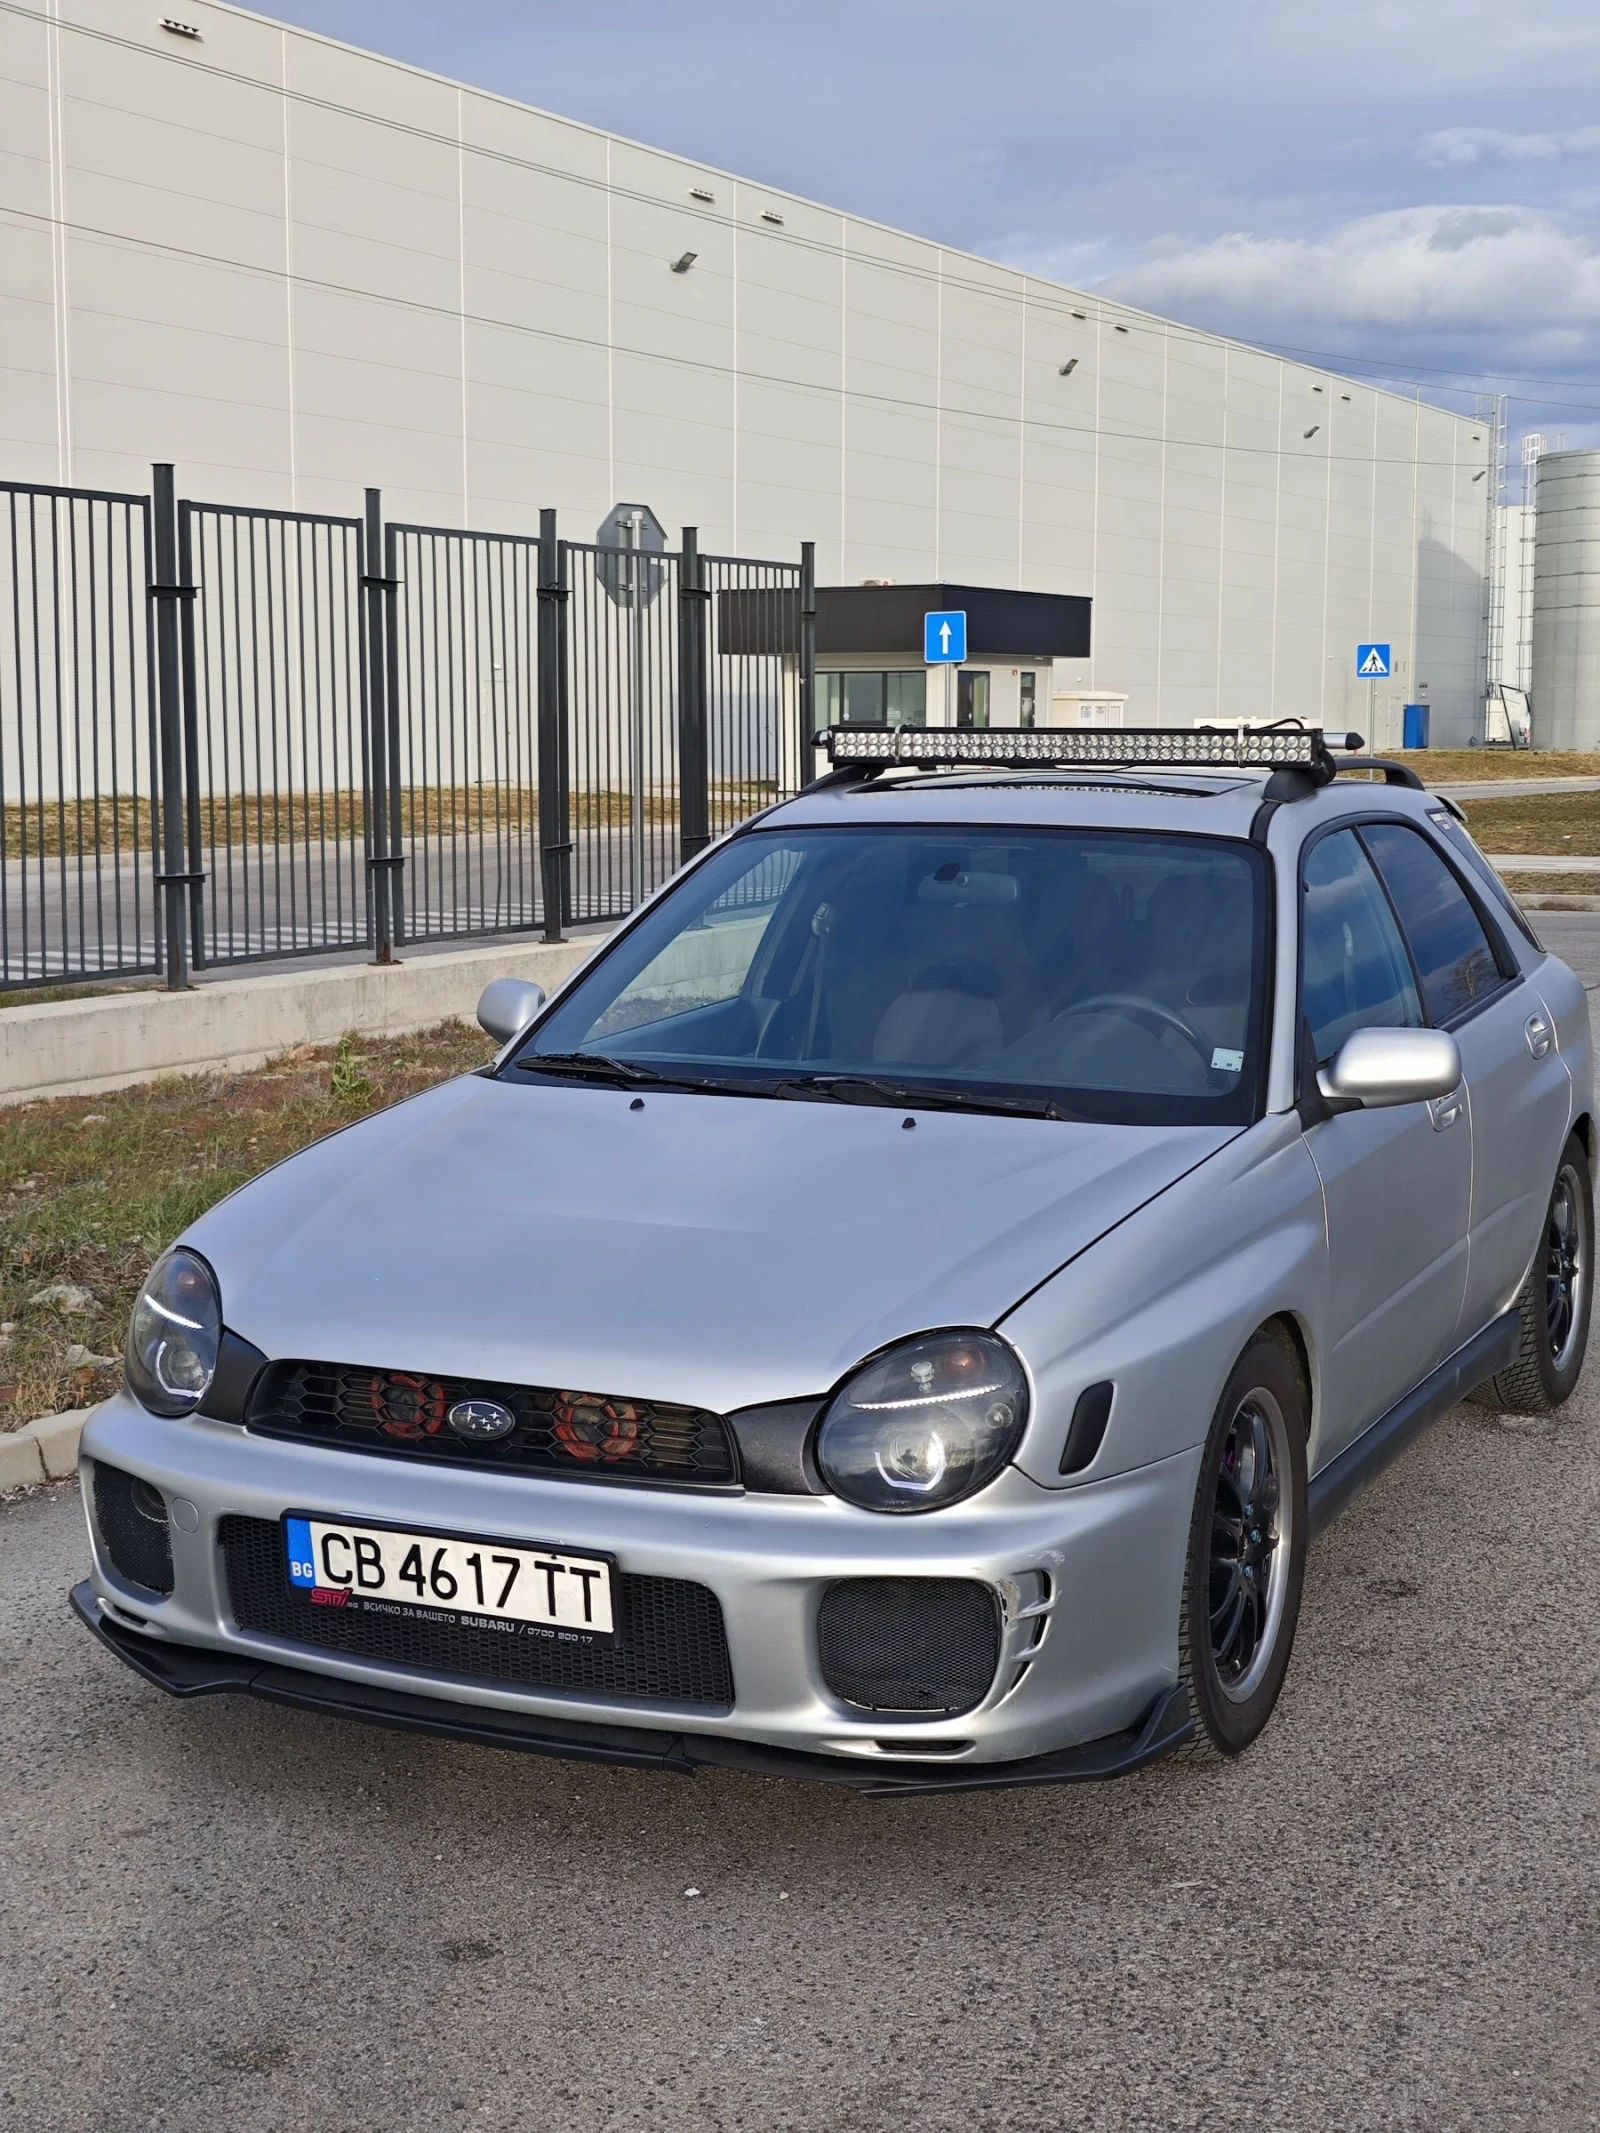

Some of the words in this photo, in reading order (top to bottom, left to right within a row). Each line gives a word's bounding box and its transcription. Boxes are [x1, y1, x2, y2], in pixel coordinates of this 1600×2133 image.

[291, 1561, 313, 1578] BG
[321, 1532, 386, 1590] CB
[399, 1544, 521, 1608] 4617
[534, 1560, 601, 1623] TT
[363, 1601, 401, 1615] ВСИЧКО
[402, 1607, 415, 1618] ЗА
[416, 1609, 456, 1624] ВАШЕТО
[460, 1615, 515, 1632] SUBARU
[527, 1627, 555, 1638] 0700
[580, 1635, 593, 1644] 17
